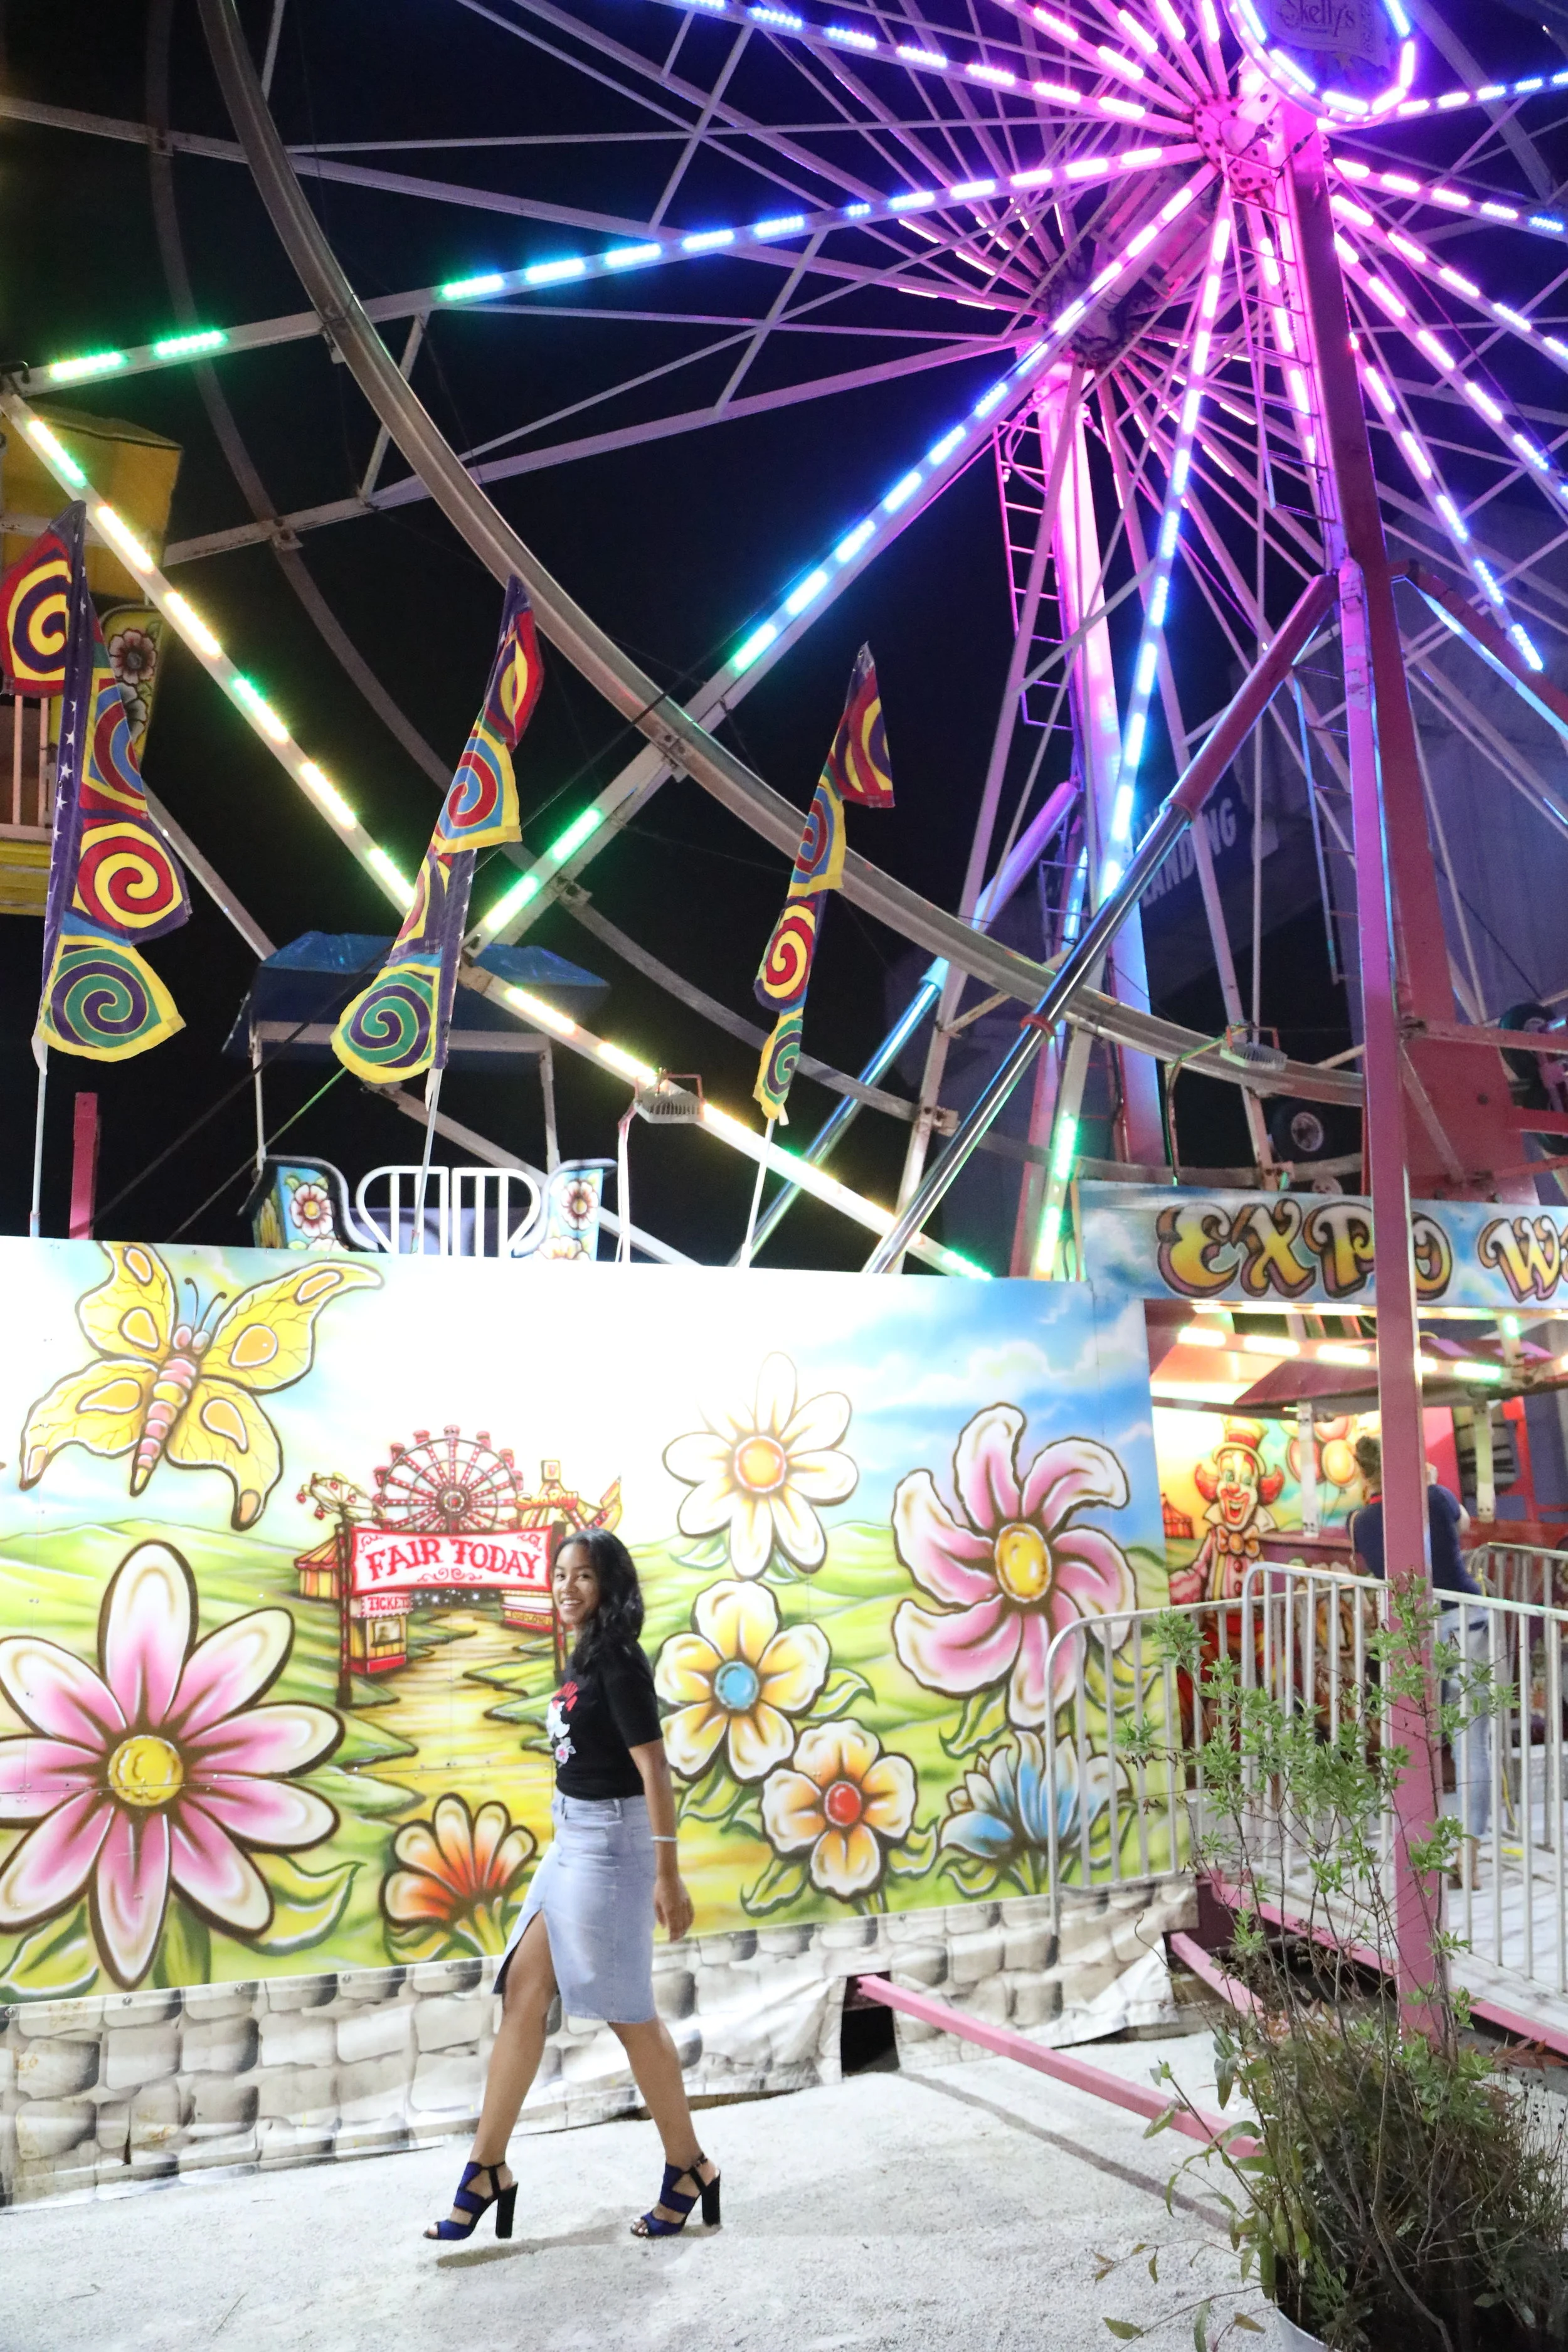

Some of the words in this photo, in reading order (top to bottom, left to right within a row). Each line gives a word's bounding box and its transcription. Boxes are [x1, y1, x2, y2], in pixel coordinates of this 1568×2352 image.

[1156, 1198, 1453, 1301] EXPO
[1478, 1215, 1568, 1303] W
[365, 1539, 443, 1581] FAIR
[449, 1538, 541, 1579] TODAY
